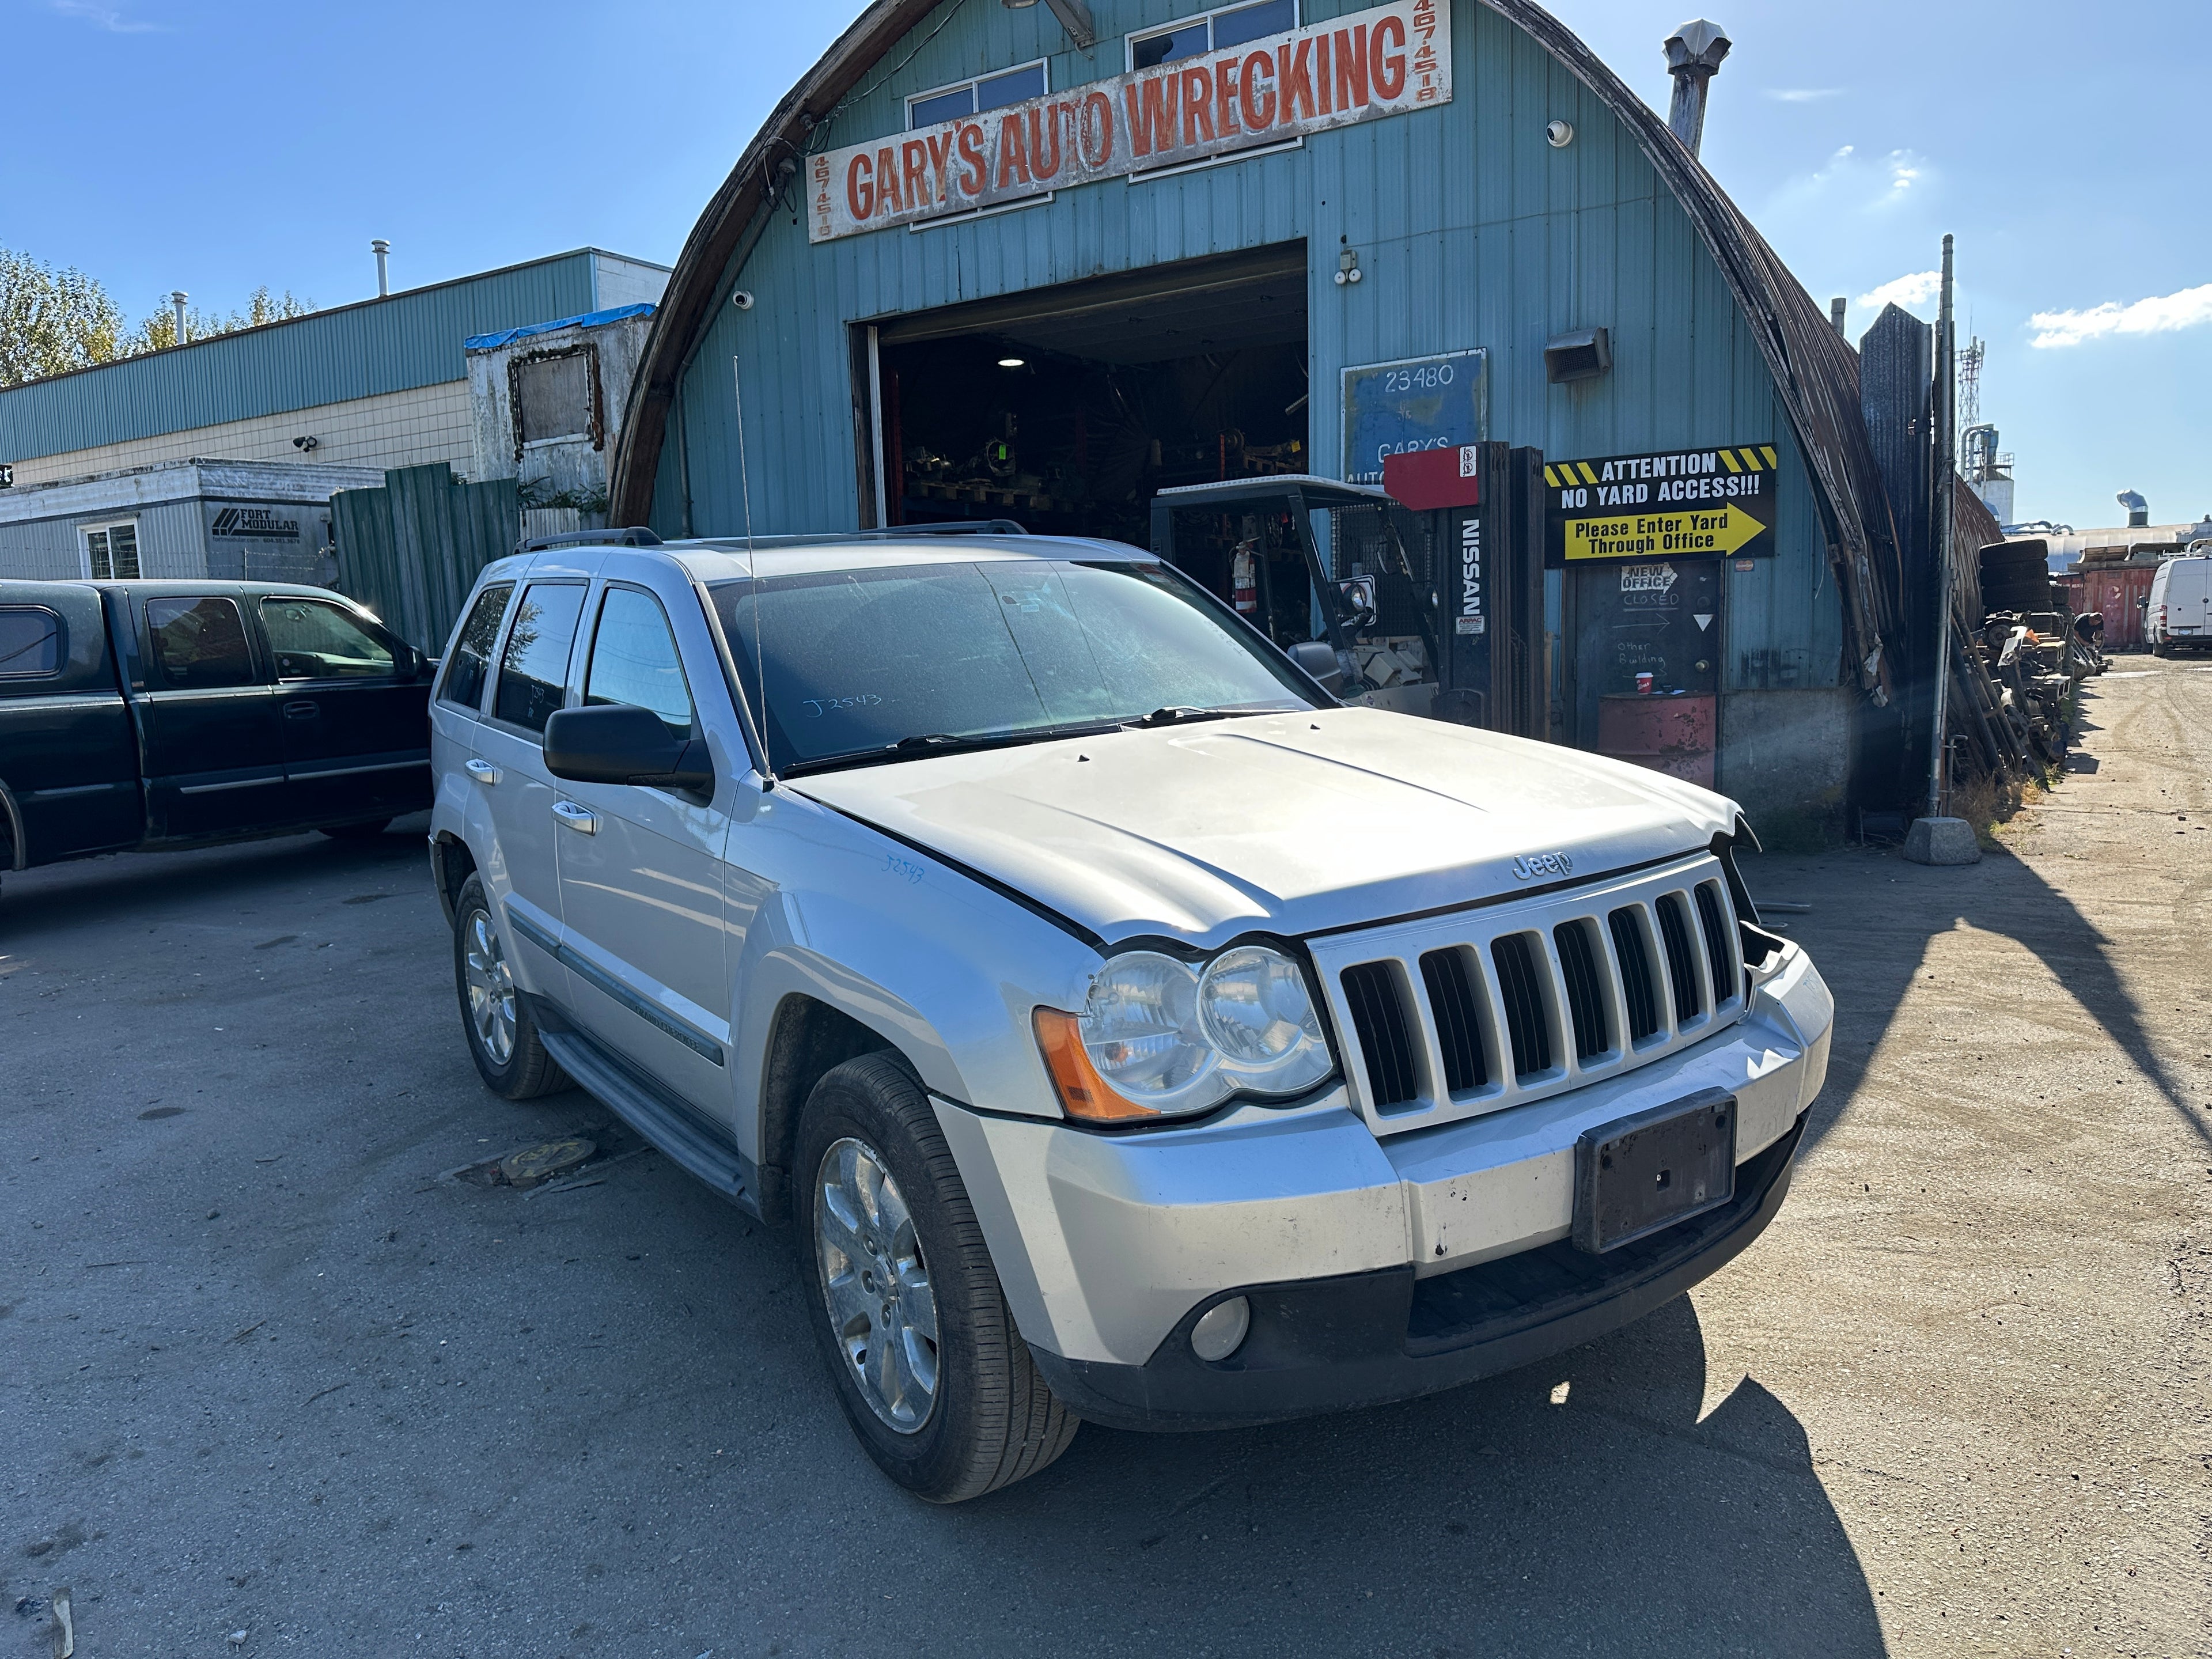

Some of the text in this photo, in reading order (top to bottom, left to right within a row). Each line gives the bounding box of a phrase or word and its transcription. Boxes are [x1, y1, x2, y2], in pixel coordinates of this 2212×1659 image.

[847, 16, 1405, 220] GARY'S AUTO WRECKING
[1385, 364, 1454, 393] 23480
[1601, 452, 1716, 482] ATTENTION
[1561, 475, 1760, 509] NO YARD ACCESS!!!
[240, 509, 271, 520] FORT
[241, 519, 299, 531] MODULAR
[1575, 513, 1728, 538] Please Enter Yard
[1588, 533, 1714, 554] Through Office
[1463, 519, 1480, 615] NISSAN
[1630, 565, 1664, 577] NEW
[1622, 575, 1671, 589] OFFICE
[1624, 593, 1679, 605] CLOSED
[1618, 642, 1651, 650] Other
[1619, 653, 1666, 669] Building
[803, 694, 882, 717] J2543
[881, 854, 925, 884] J2543
[1512, 851, 1573, 880] Jeep
